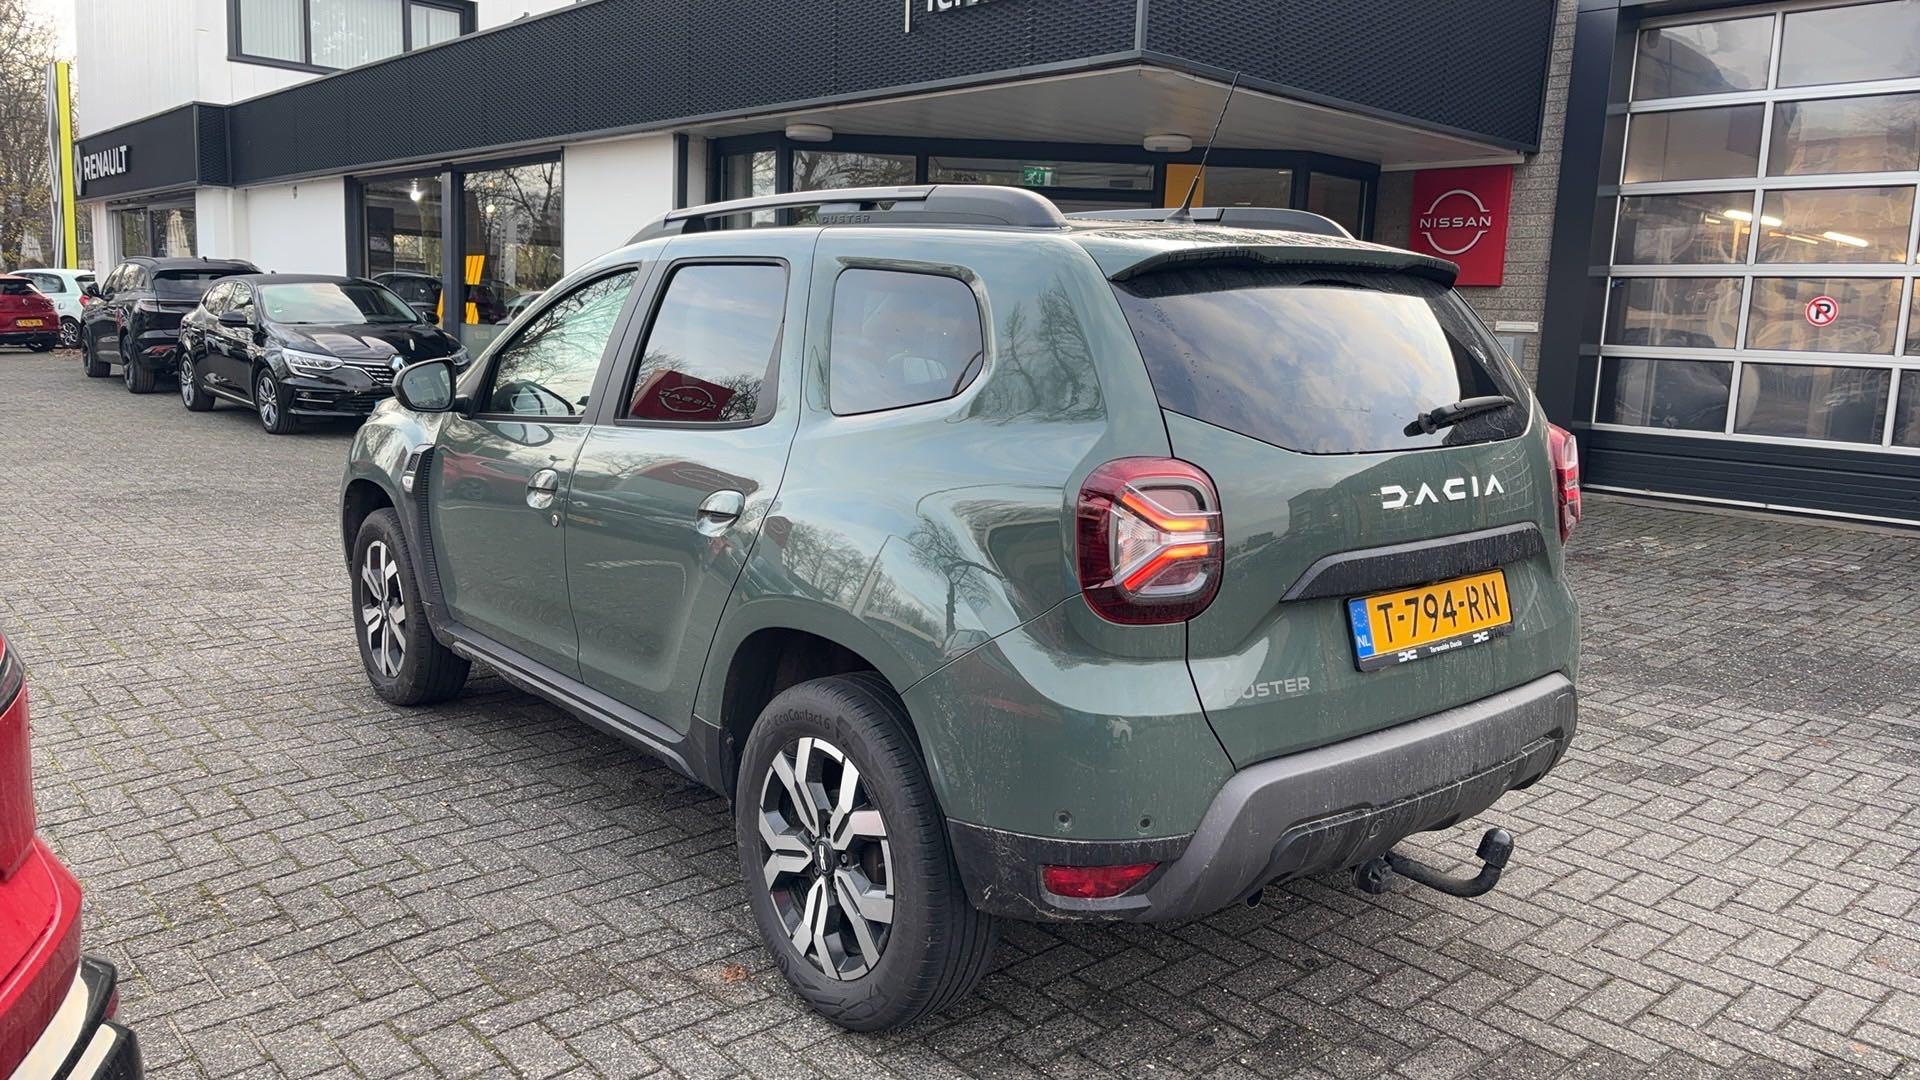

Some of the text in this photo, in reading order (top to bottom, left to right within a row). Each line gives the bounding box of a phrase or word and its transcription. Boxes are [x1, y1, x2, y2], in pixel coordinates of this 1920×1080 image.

[83, 145, 127, 180] RENAULT
[822, 213, 871, 224] DUSTER
[1419, 216, 1491, 228] NISSAN
[1380, 474, 1504, 509] DACIA
[1377, 581, 1501, 643] T-794-RN
[1357, 635, 1371, 648] NL
[1223, 676, 1311, 699] USTER
